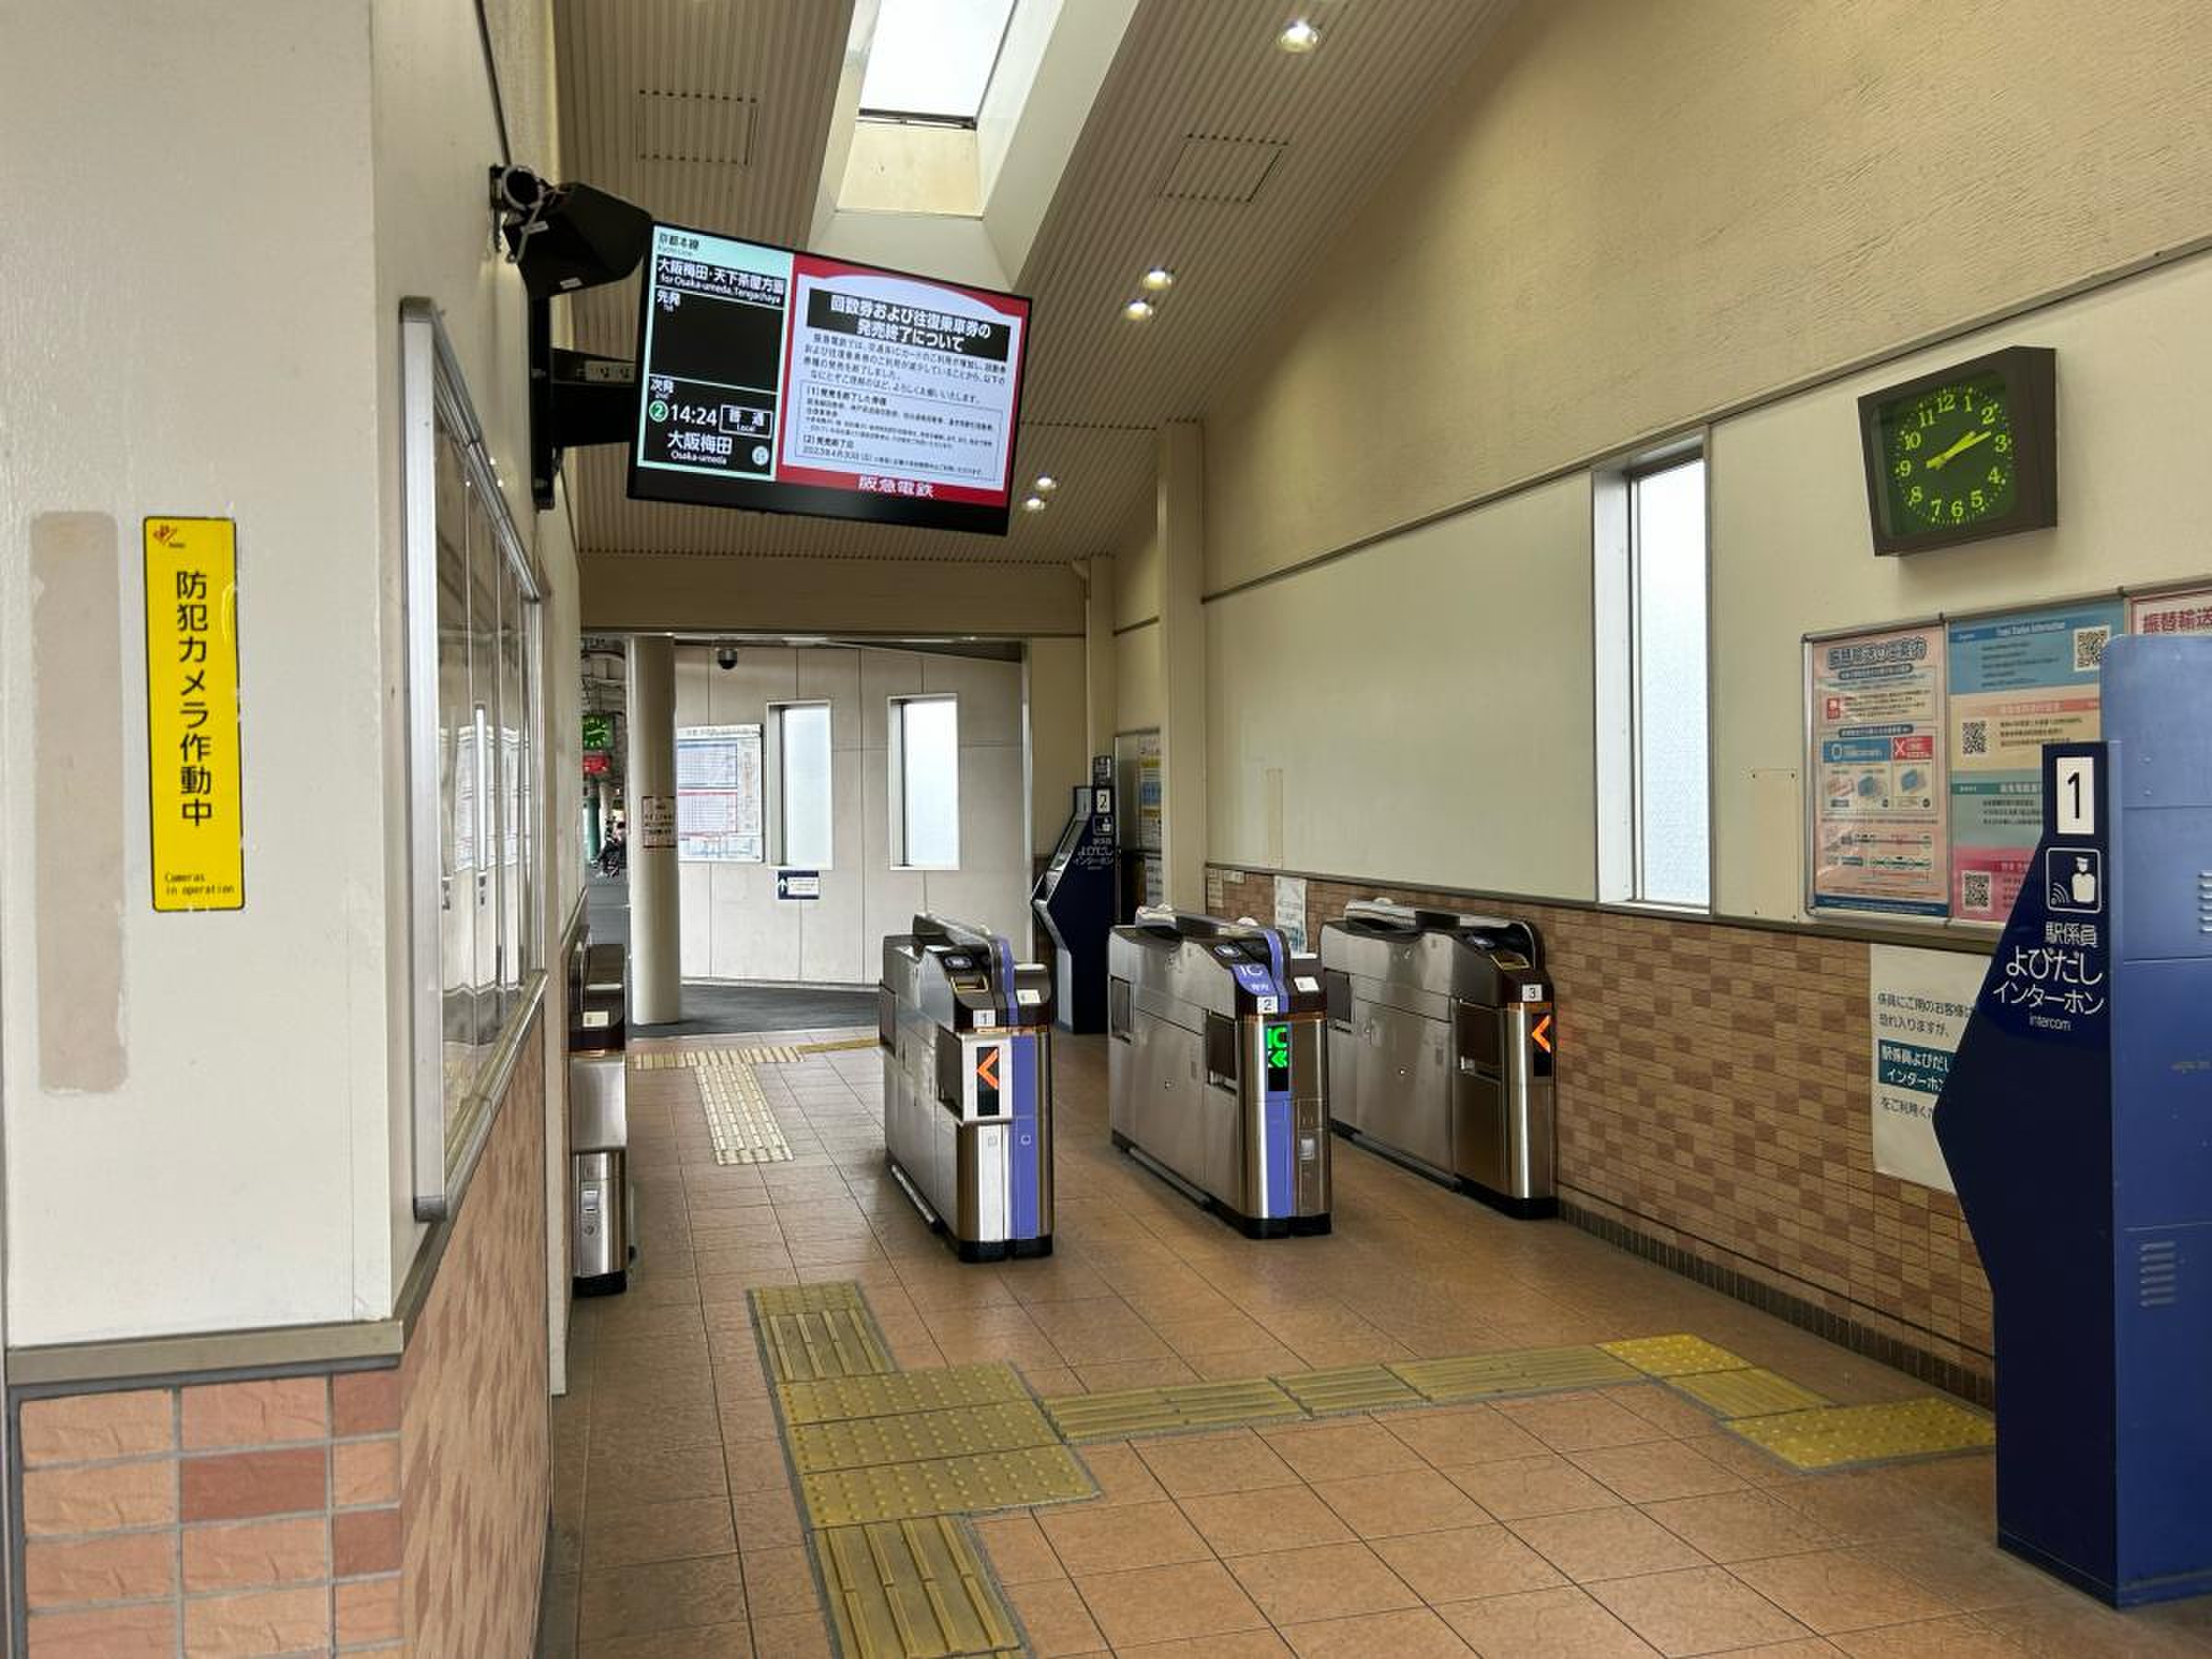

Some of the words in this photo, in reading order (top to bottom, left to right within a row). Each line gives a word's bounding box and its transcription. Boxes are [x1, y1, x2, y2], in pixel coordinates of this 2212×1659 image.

[855, 322, 965, 352] 発売終了について
[1936, 394, 1956, 413] 12
[1964, 395, 1973, 412] 1
[670, 404, 717, 427] 14:24
[1919, 408, 1936, 428] 11
[1982, 406, 1995, 425] 2
[667, 429, 733, 455] 大阪梅田
[1905, 432, 1922, 451] 10
[1994, 434, 2007, 453] 3
[1900, 460, 1912, 477] 9
[1988, 466, 2001, 484] 4
[858, 476, 934, 499] 阪急電鉄
[1911, 487, 1923, 502] 8
[1931, 500, 1942, 517] 7
[1971, 490, 1983, 508] 5
[1951, 501, 1963, 517] 6
[176, 571, 213, 828] 防犯カメラ作動中
[2067, 771, 2080, 819] 1
[165, 871, 206, 882] Cameras
[167, 885, 178, 896] in
[182, 884, 236, 897] operation
[2045, 922, 2098, 947] 駅係員
[1240, 965, 1264, 976] IC
[2006, 945, 2103, 985] よびだし
[1264, 999, 1272, 1011] 2
[1993, 981, 2104, 1015] インターホン
[1267, 1028, 1288, 1049] IC
